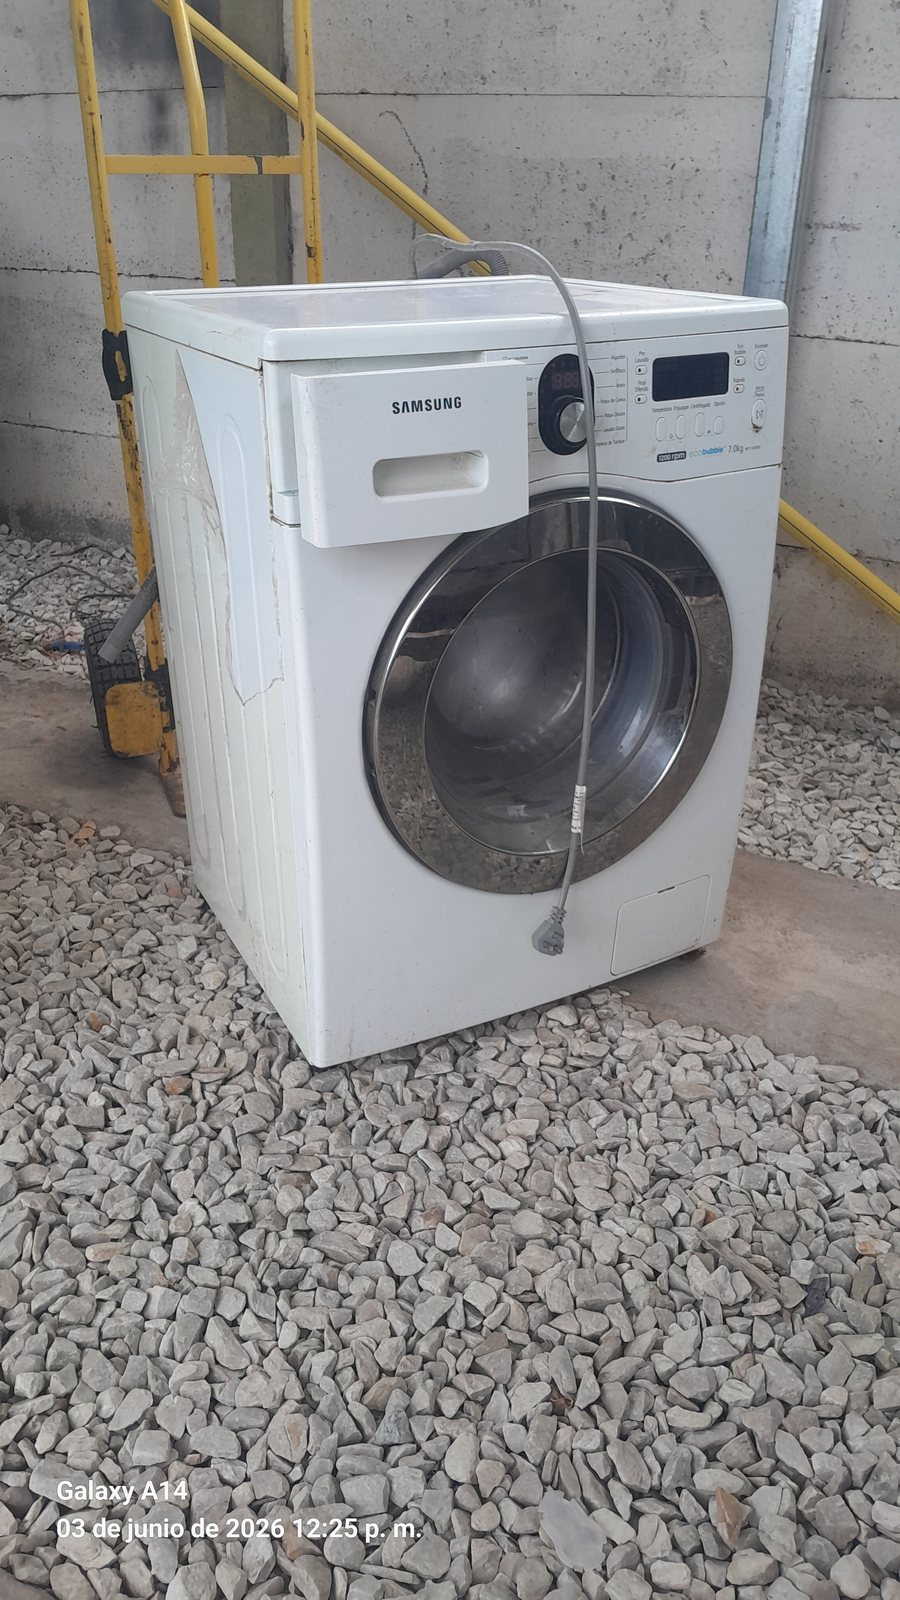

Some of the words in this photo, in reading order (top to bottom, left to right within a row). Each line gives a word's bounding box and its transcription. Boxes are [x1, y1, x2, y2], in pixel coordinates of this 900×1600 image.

[392, 396, 462, 415] SAMSUNG
[728, 444, 744, 454] 7.0kg
[658, 454, 671, 462] 1200
[672, 452, 686, 461] rpm
